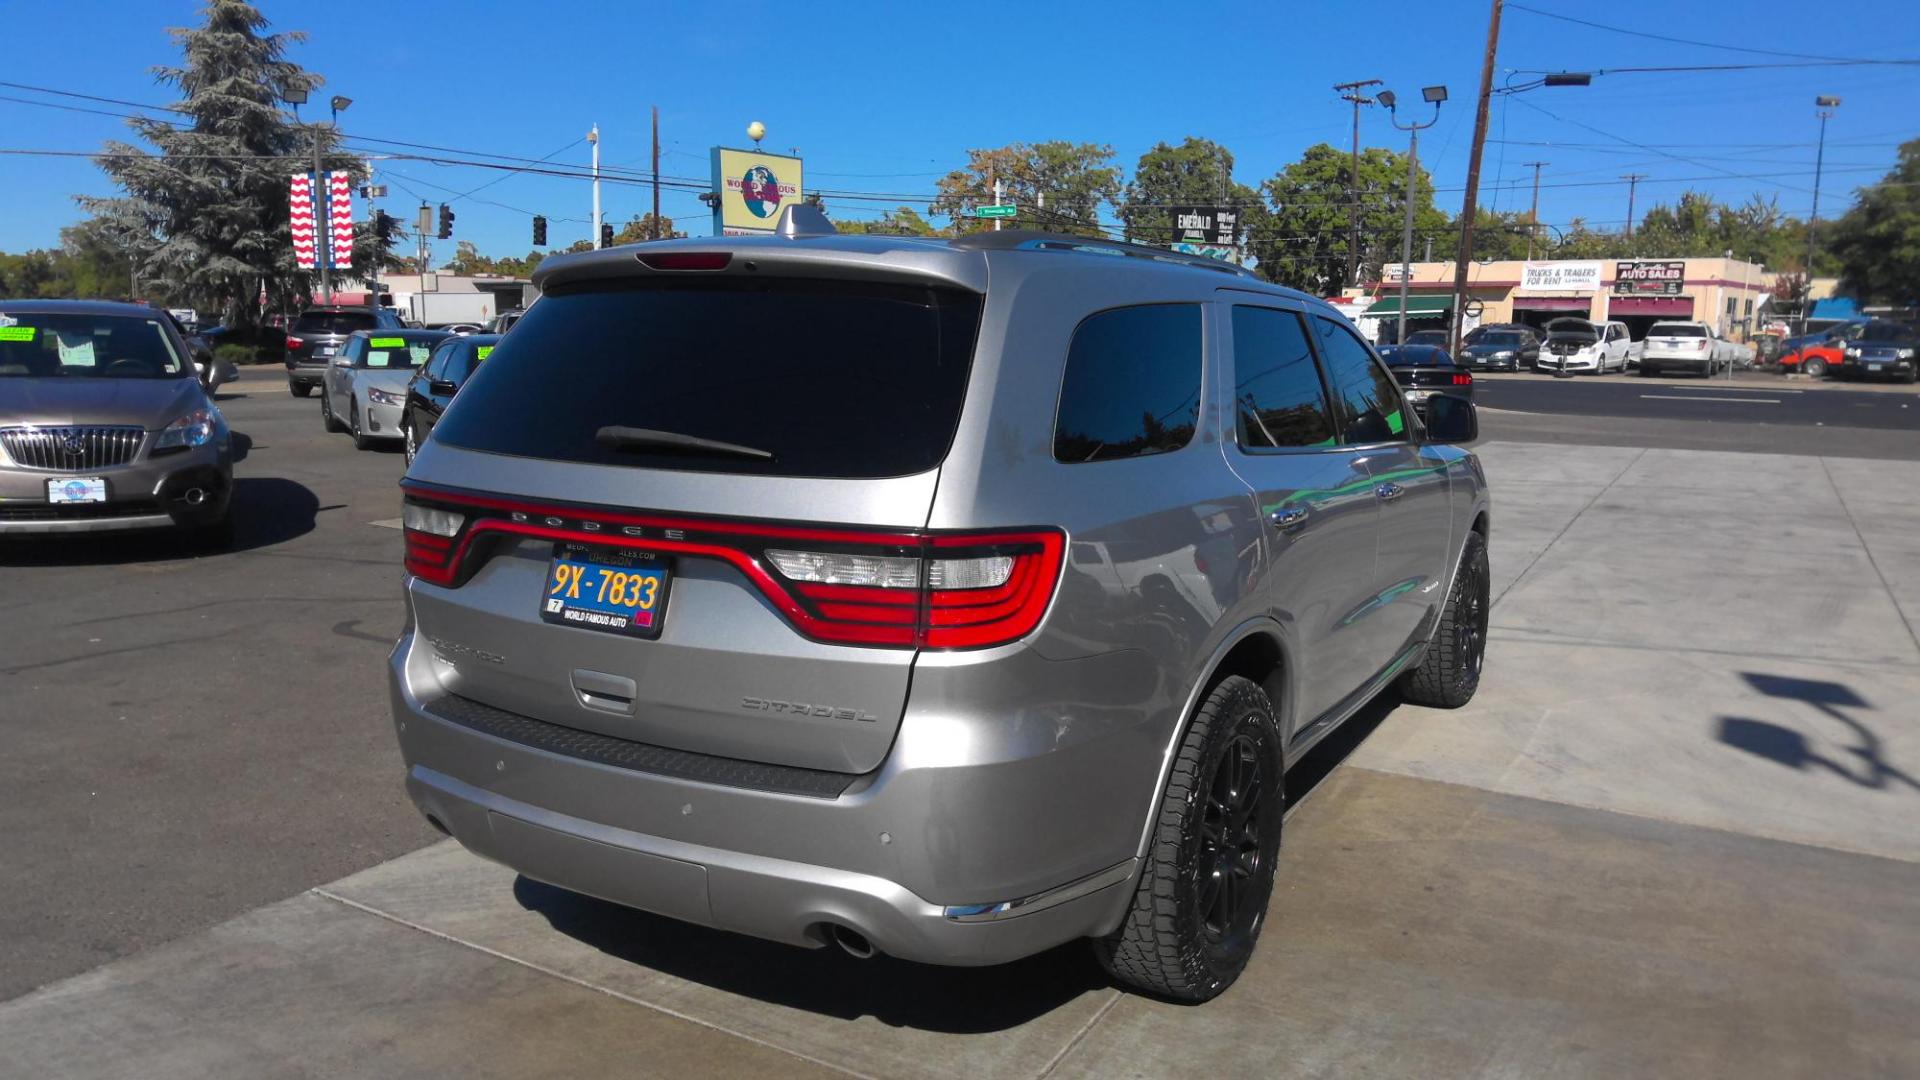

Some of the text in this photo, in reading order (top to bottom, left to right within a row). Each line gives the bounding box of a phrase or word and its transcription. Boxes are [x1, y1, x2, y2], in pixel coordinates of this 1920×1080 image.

[1177, 214, 1211, 230] EMERALD
[1526, 277, 1541, 286] FOR
[1543, 276, 1562, 286] RENT
[1527, 268, 1597, 277] TRUCKS & TRAILERS
[1621, 269, 1680, 280] AUTO SALES
[511, 511, 685, 541] DODGE
[551, 563, 659, 610] 9X-7833
[564, 609, 586, 622] WORLD
[584, 612, 610, 626] FAMOUS
[609, 617, 628, 629] AUTO
[741, 696, 877, 723] CITADEL
